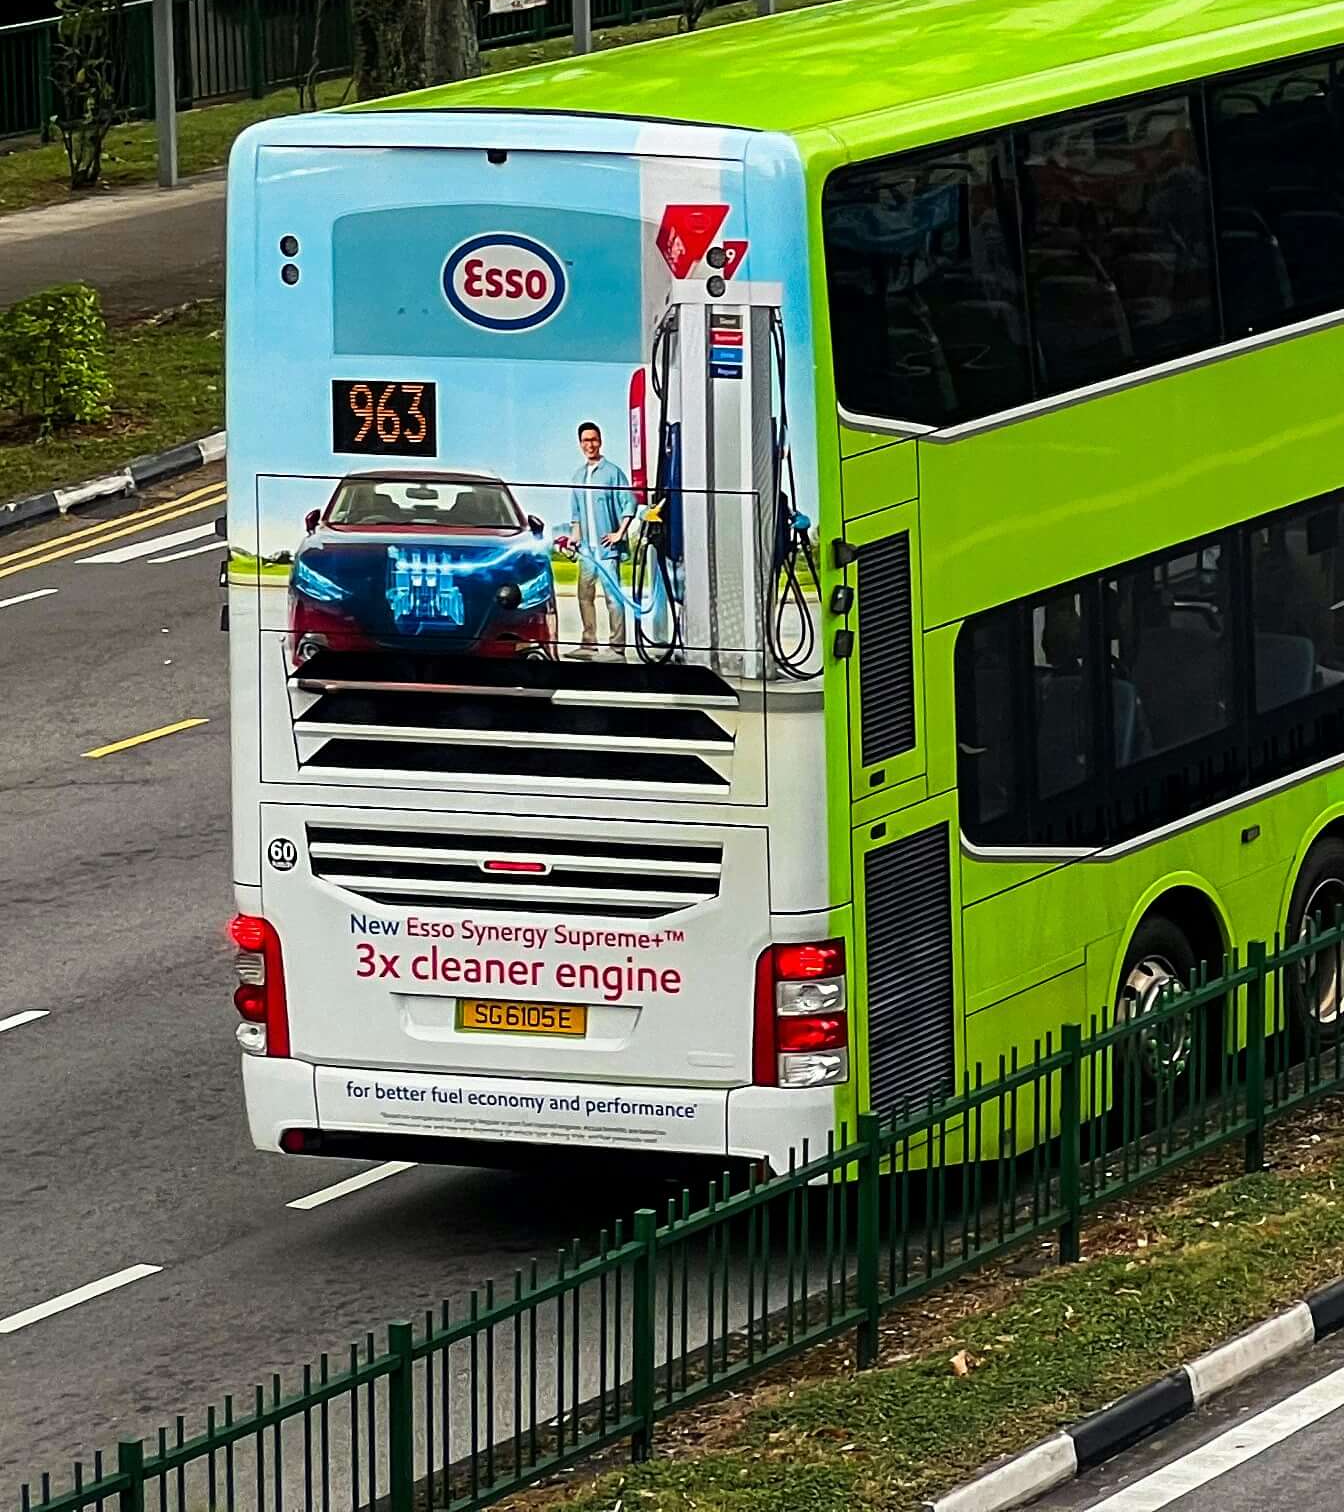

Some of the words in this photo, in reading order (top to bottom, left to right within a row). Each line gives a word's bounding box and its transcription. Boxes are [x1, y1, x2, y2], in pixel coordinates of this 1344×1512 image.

[464, 259, 547, 300] Esso
[349, 384, 427, 443] 963
[270, 841, 295, 861] 60
[350, 914, 400, 936] New
[406, 917, 455, 939] Esso
[461, 919, 549, 950] Synergy
[356, 944, 401, 979] 3x
[411, 945, 545, 987] cleaner
[555, 956, 682, 1001] engine
[346, 1081, 370, 1099] for
[375, 1083, 426, 1103] better
[432, 1086, 463, 1105] fuel
[468, 1091, 546, 1114] economy
[549, 1094, 580, 1112] and
